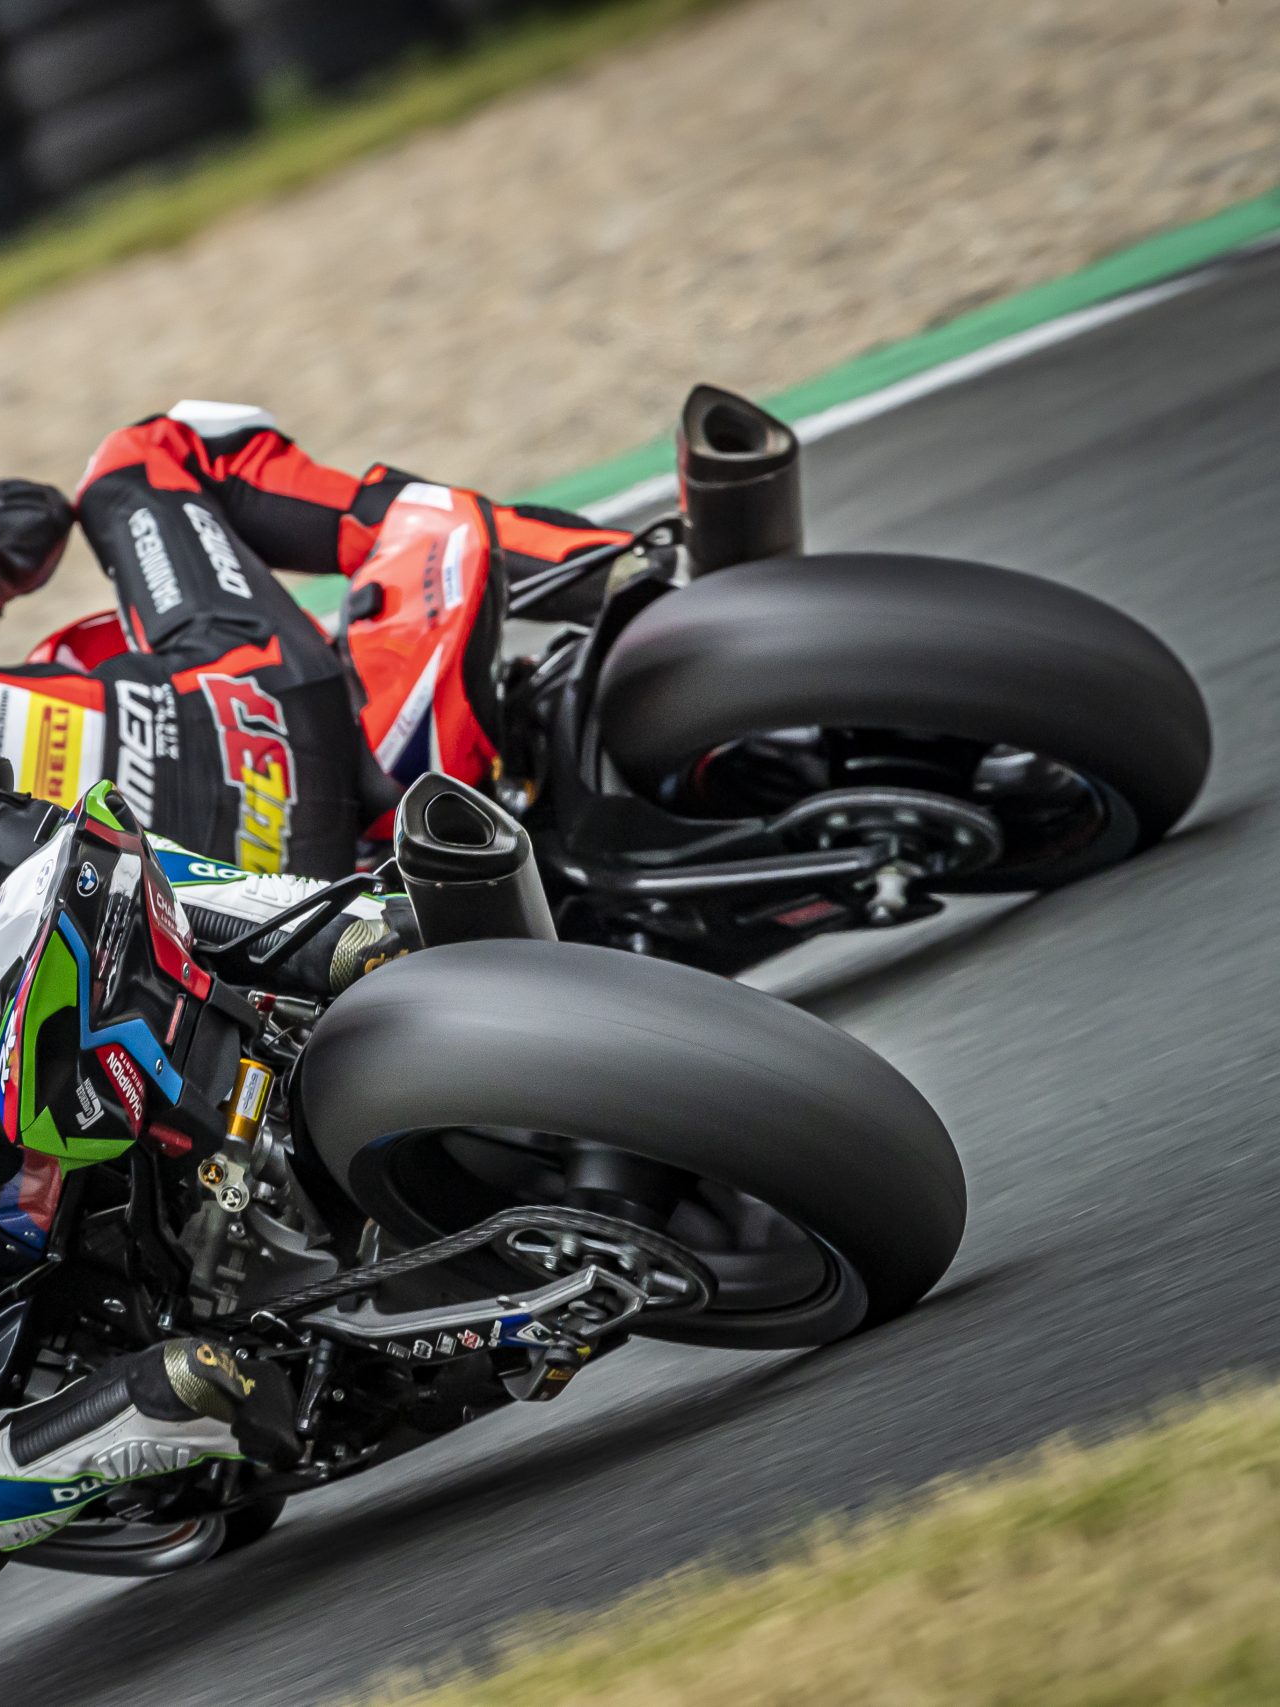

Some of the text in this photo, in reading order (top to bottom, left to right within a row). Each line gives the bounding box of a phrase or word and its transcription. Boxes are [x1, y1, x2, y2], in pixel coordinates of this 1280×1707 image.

[43, 705, 70, 798] RELLI
[116, 680, 158, 828] MEN
[107, 1051, 143, 1121] CHAMPION
